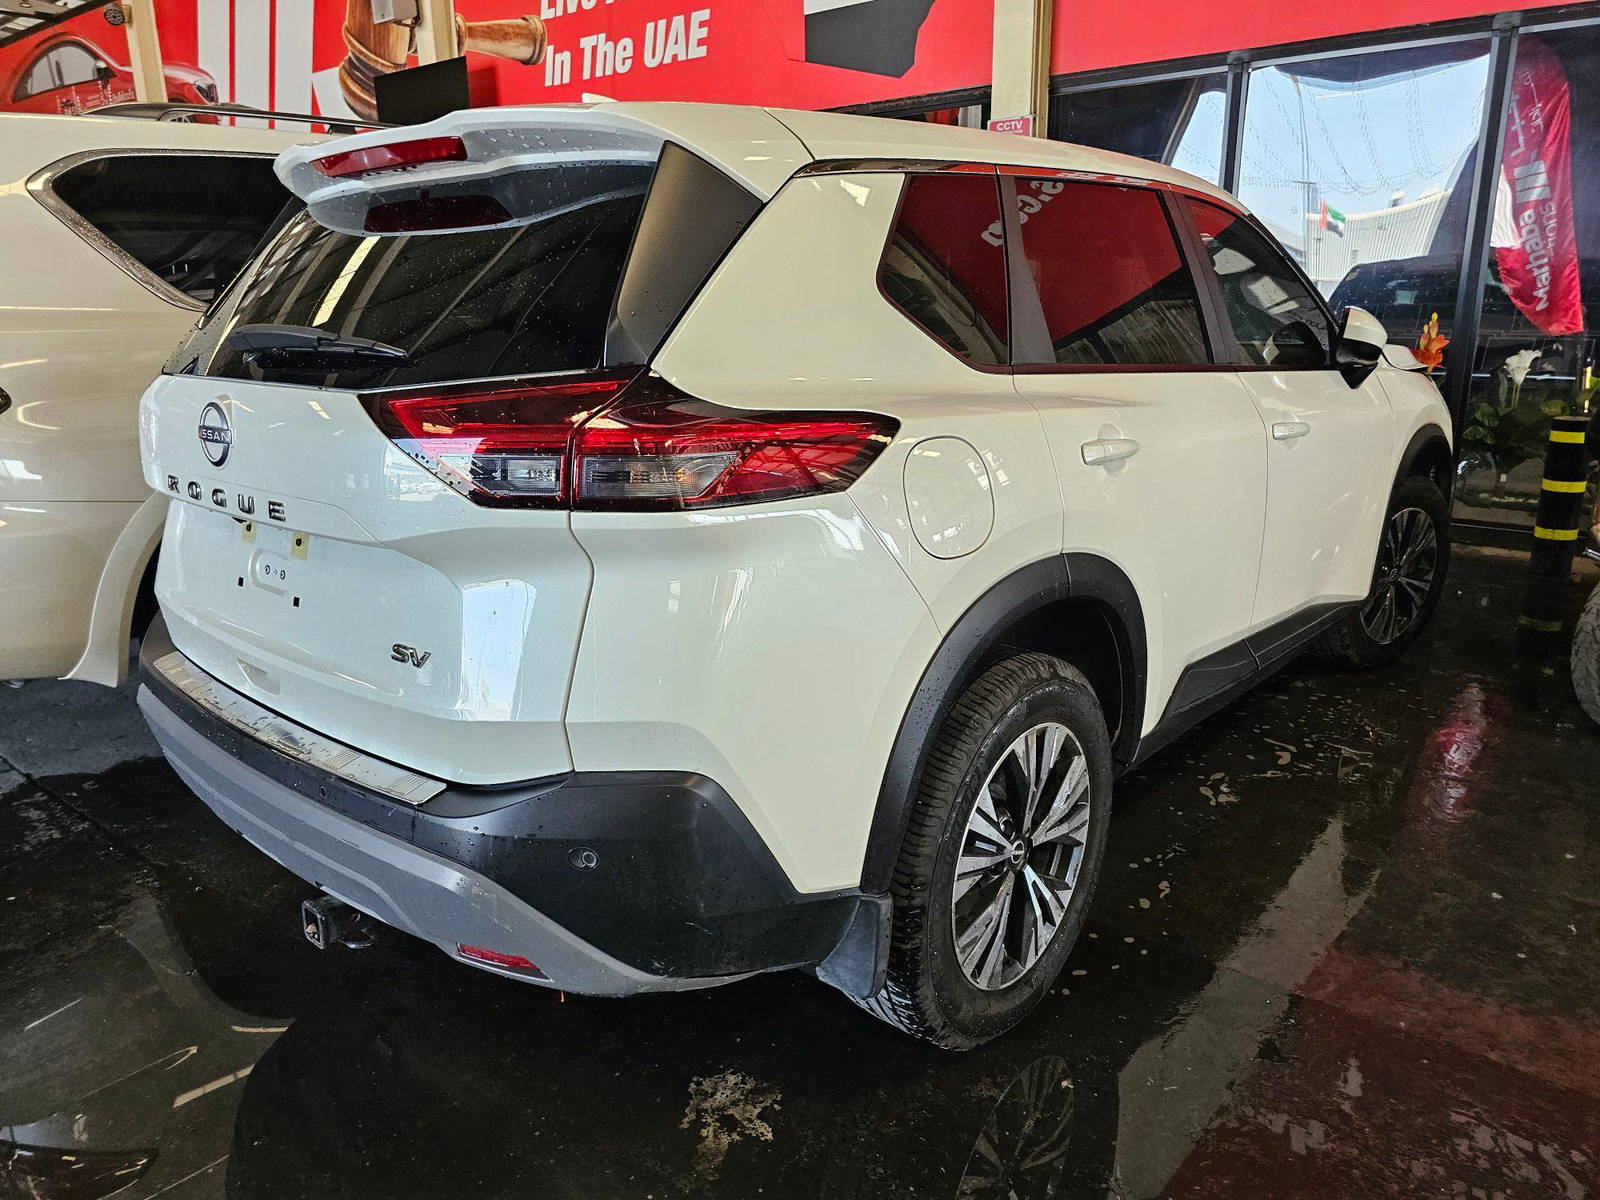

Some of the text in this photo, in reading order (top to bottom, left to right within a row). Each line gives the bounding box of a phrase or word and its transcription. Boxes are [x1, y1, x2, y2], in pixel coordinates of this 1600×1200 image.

[545, 44, 572, 87] In
[580, 32, 634, 81] The
[644, 8, 711, 69] UAE
[996, 120, 1023, 131] CCTV
[1519, 208, 1551, 312] Marhaba
[167, 474, 287, 523] ROGUE
[390, 643, 432, 669] SV
